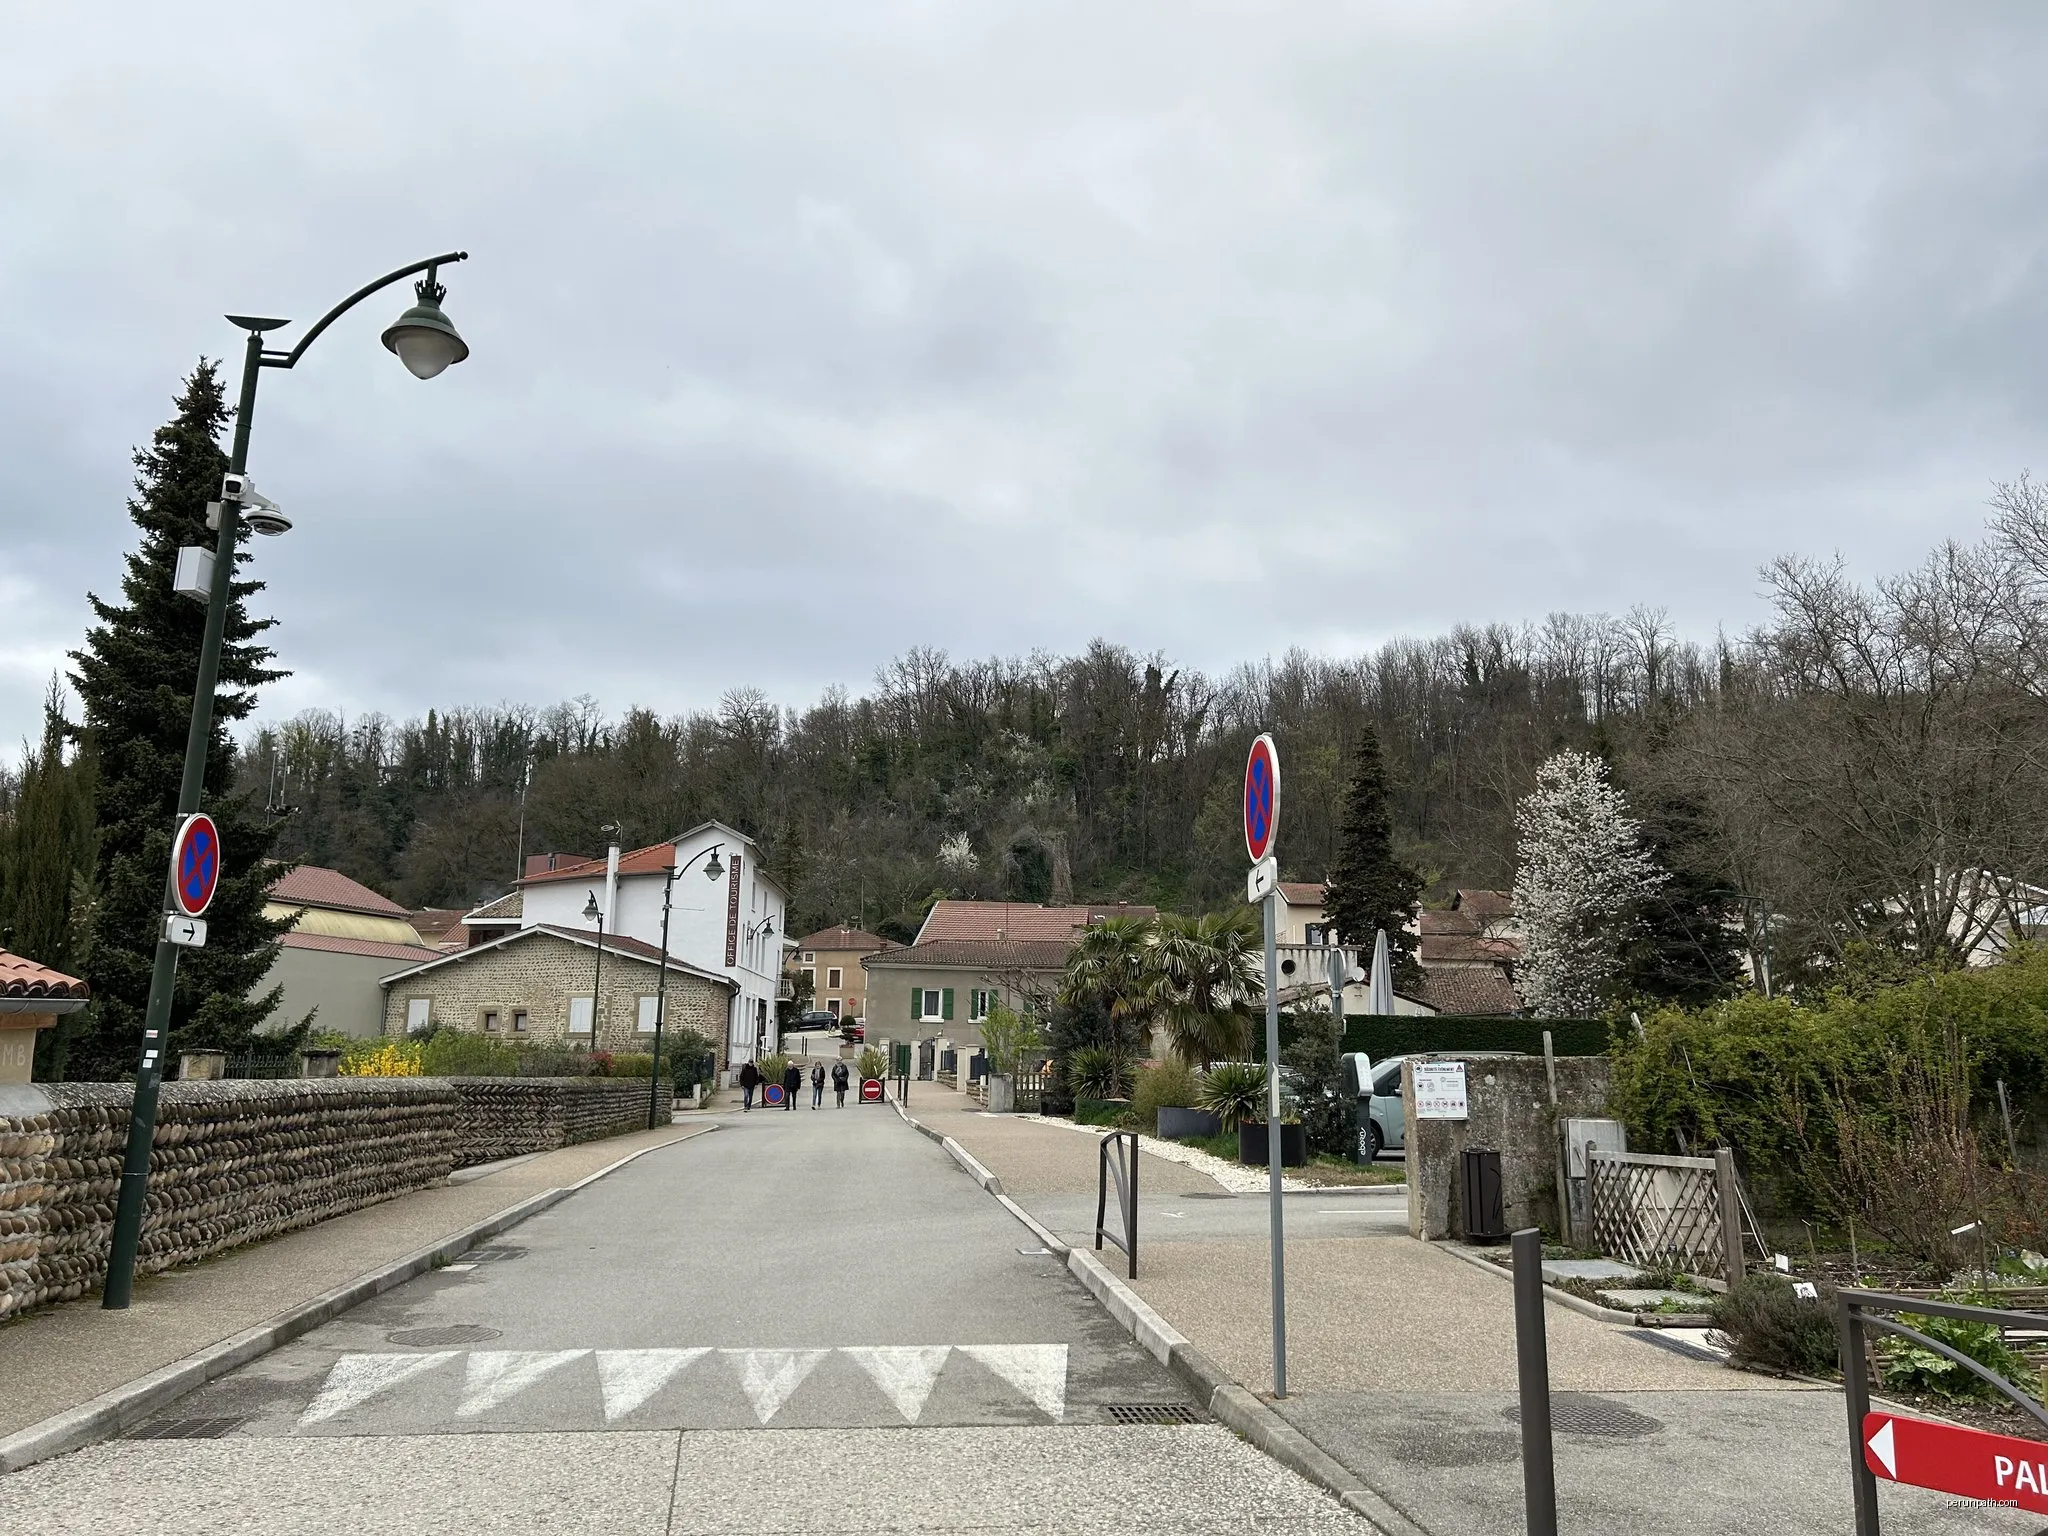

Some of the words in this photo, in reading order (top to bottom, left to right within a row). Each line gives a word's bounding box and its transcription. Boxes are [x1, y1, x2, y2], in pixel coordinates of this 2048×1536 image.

[729, 859, 740, 911] TOURISME
[728, 913, 738, 925] DE
[726, 925, 736, 965] OFFICE
[1994, 1455, 2048, 1496] PAL
